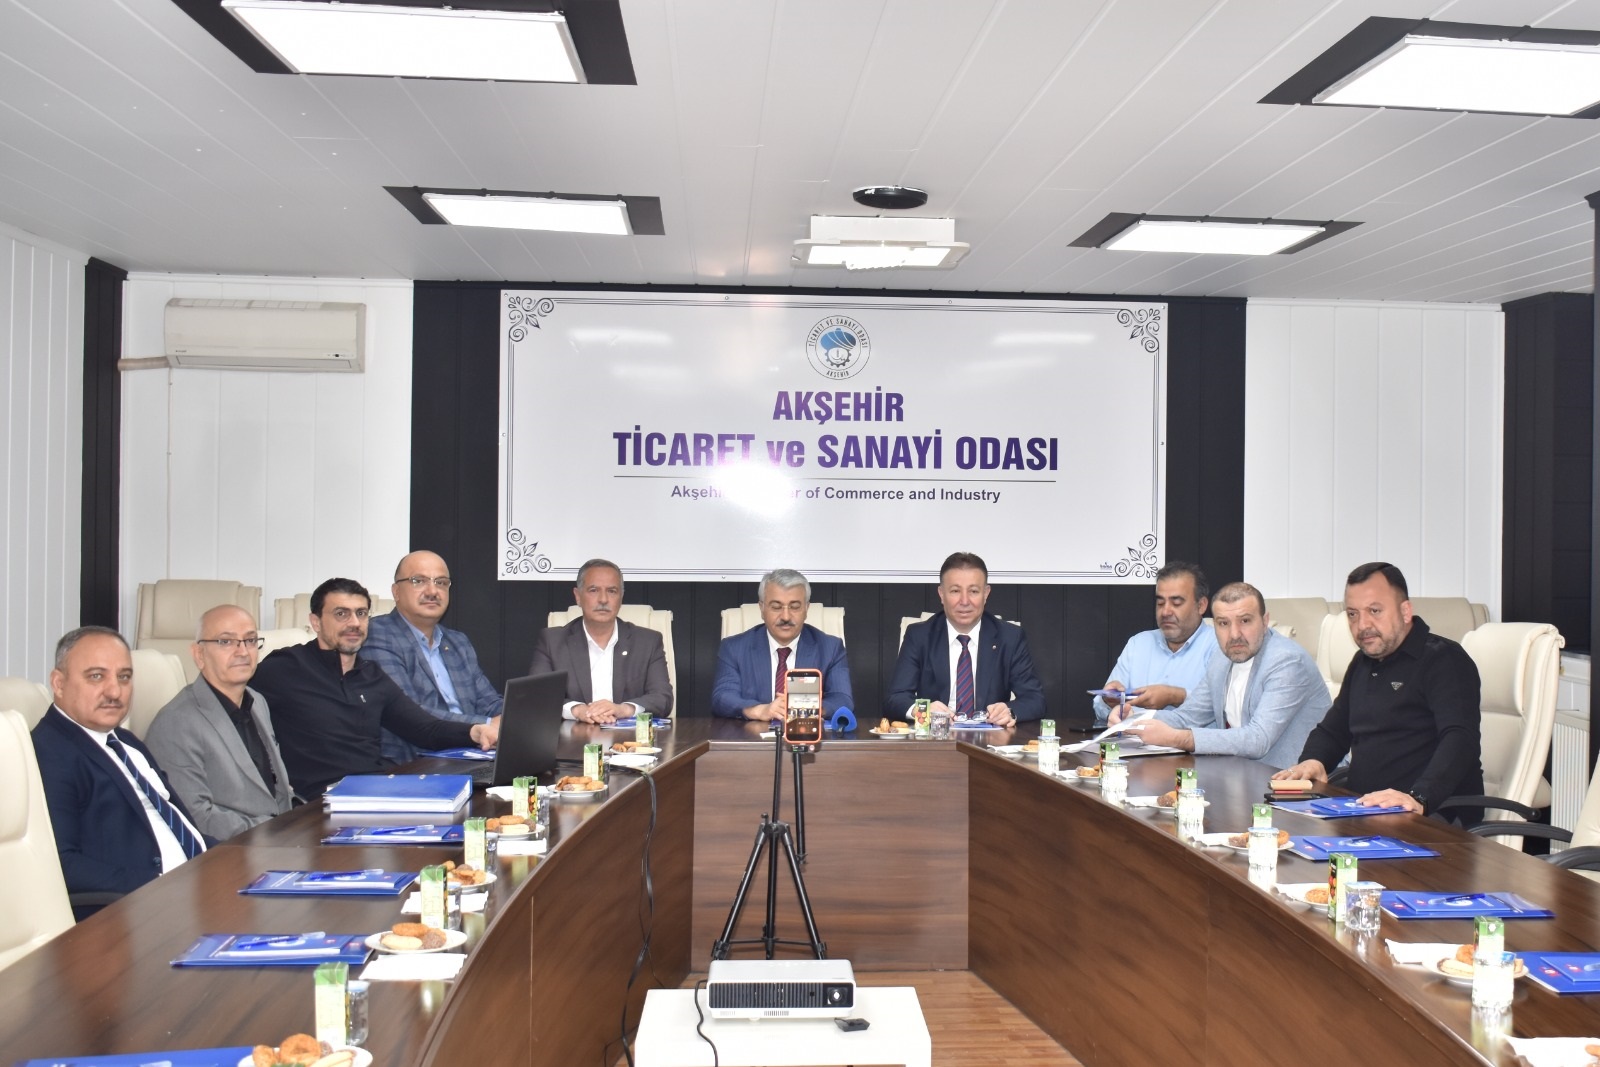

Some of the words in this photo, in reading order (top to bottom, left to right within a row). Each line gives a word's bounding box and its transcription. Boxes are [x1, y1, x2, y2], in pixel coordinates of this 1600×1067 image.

[857, 330, 869, 348] ODASI
[773, 385, 904, 425] AKŞEHİR
[613, 425, 755, 467] TİCARET
[766, 440, 805, 468] ve
[818, 428, 943, 469] SANAYİ
[956, 436, 1059, 471] ODASI
[671, 485, 724, 501] Akşehi
[806, 487, 820, 499] of
[825, 487, 905, 500] Commerce
[909, 488, 936, 501] and
[940, 488, 1000, 503] Industry
